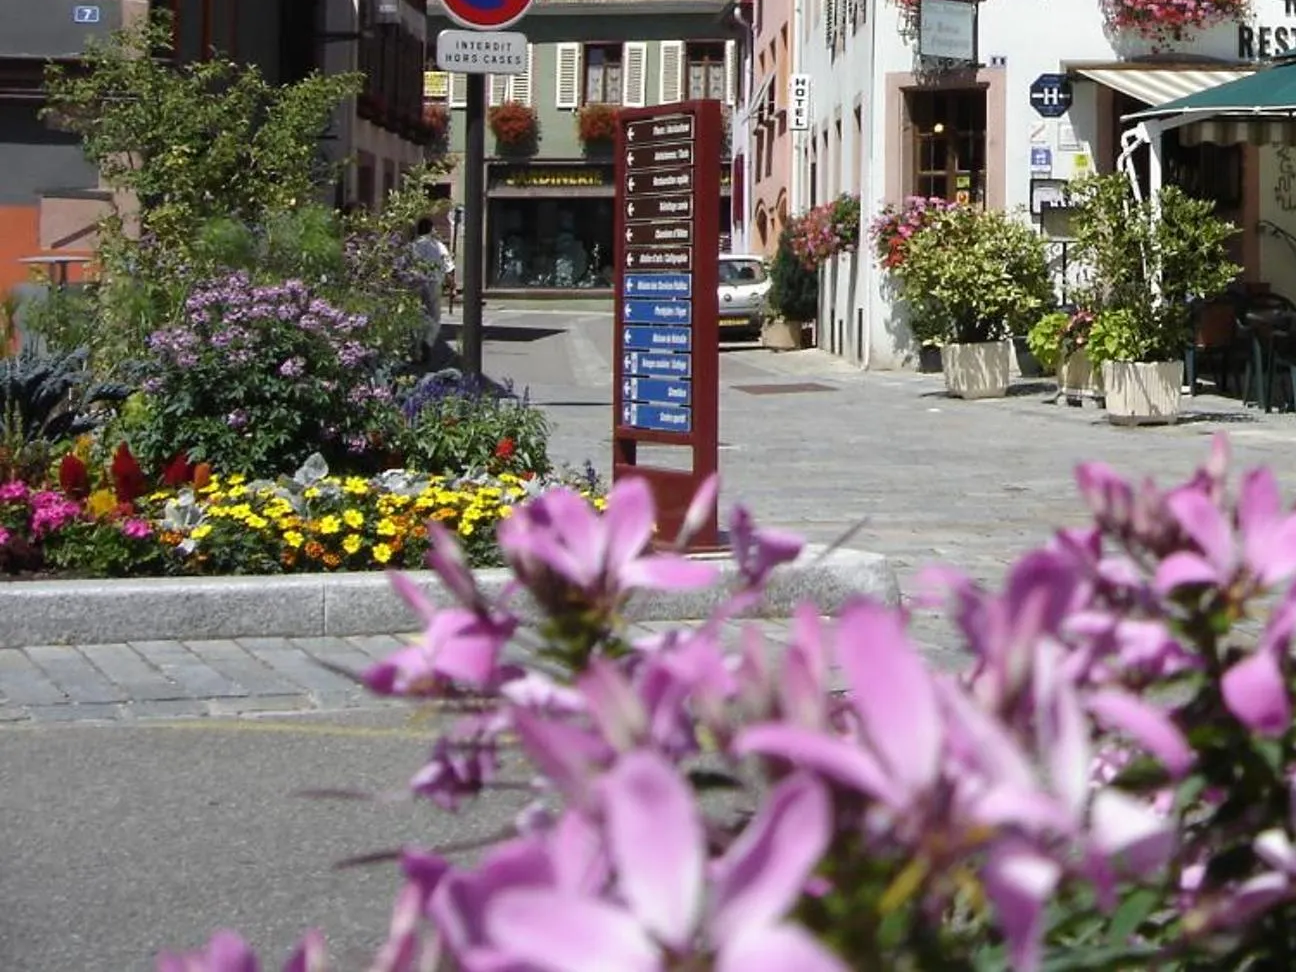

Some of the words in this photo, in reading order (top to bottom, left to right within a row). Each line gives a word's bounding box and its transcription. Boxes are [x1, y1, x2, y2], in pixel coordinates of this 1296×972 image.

[83, 8, 92, 20] 7
[455, 40, 512, 52] INTERDIT
[445, 53, 477, 63] HORS
[483, 54, 521, 65] CASES
[795, 77, 805, 126] HOTEL
